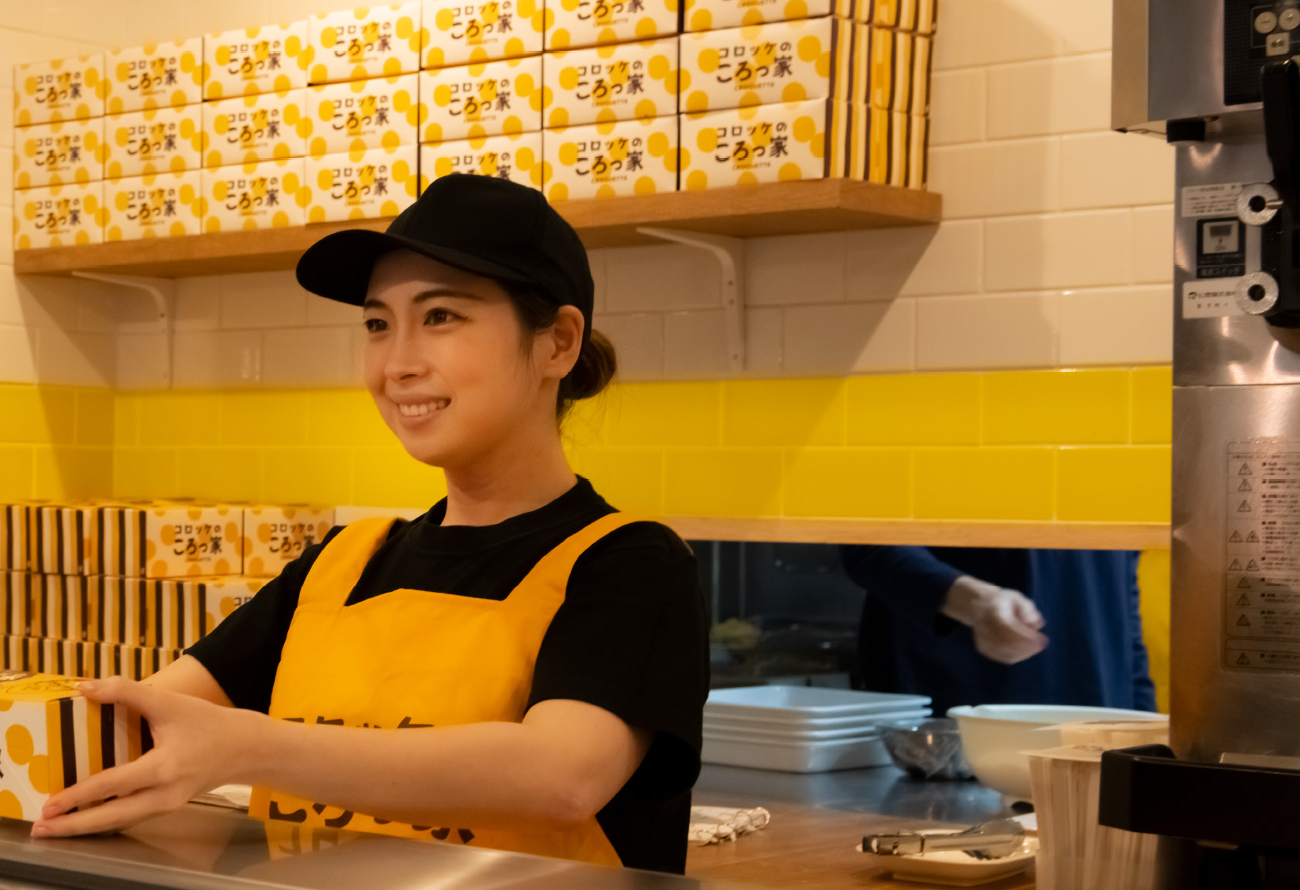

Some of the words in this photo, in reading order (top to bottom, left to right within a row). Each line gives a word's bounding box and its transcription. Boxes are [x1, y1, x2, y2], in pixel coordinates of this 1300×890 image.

[718, 41, 792, 59] コロッケの
[578, 60, 643, 77] コロッケの
[716, 55, 793, 84] ころっ家
[576, 74, 644, 100] ころっ家
[449, 91, 511, 117] ころっ家
[716, 122, 787, 138] コロッケの
[578, 137, 642, 152] コロッケの
[715, 135, 788, 163] ころっ家
[576, 150, 643, 176] ころっ家
[174, 524, 222, 535] コロッケの
[173, 536, 223, 556] ころっ家
